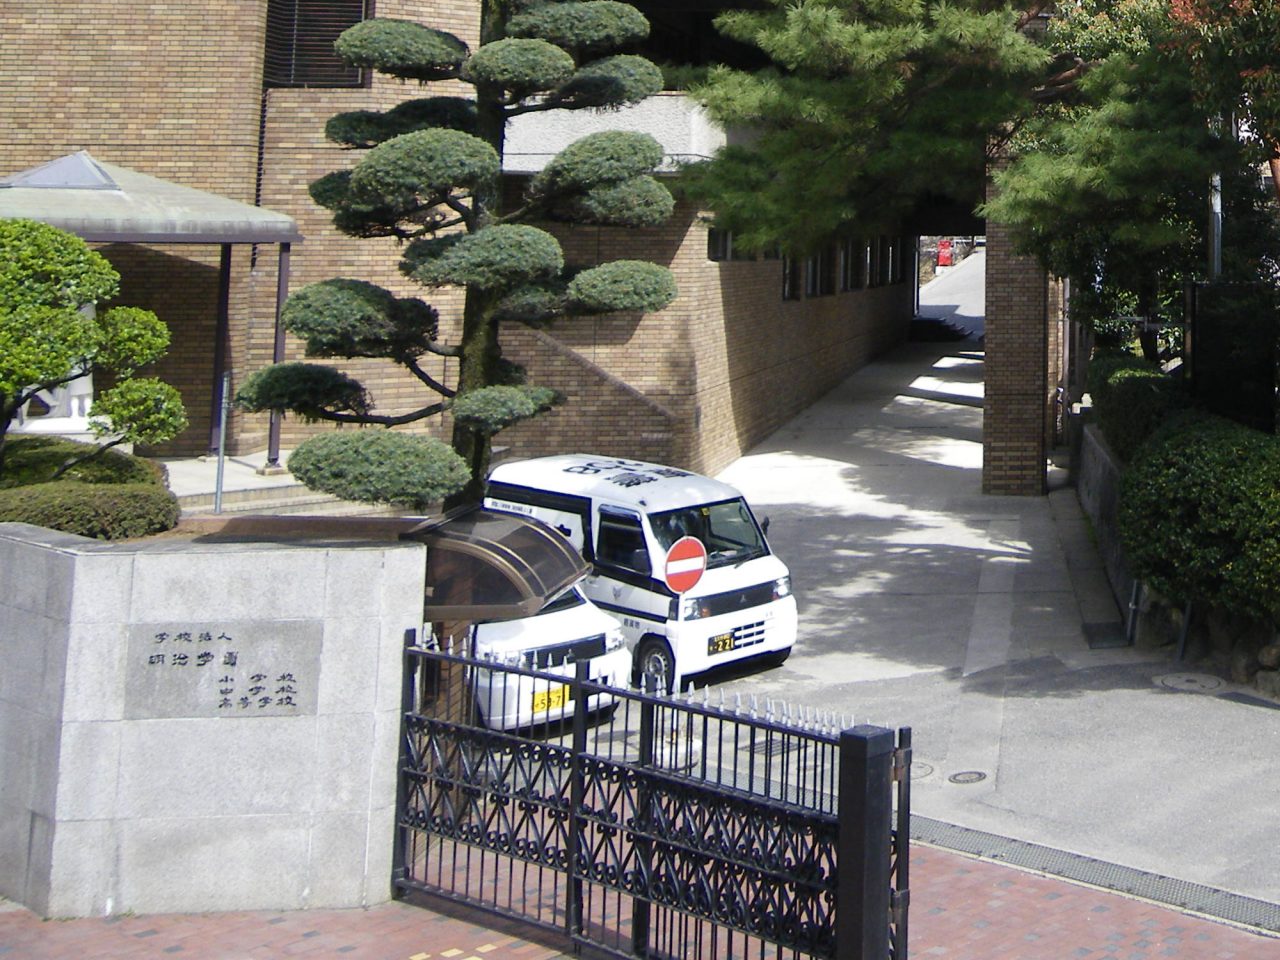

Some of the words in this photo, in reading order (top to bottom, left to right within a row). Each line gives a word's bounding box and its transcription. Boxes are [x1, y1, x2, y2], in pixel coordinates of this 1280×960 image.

[154, 632, 232, 644] 学校法人
[218, 673, 296, 683] 小学校
[218, 696, 297, 709] 高等学校
